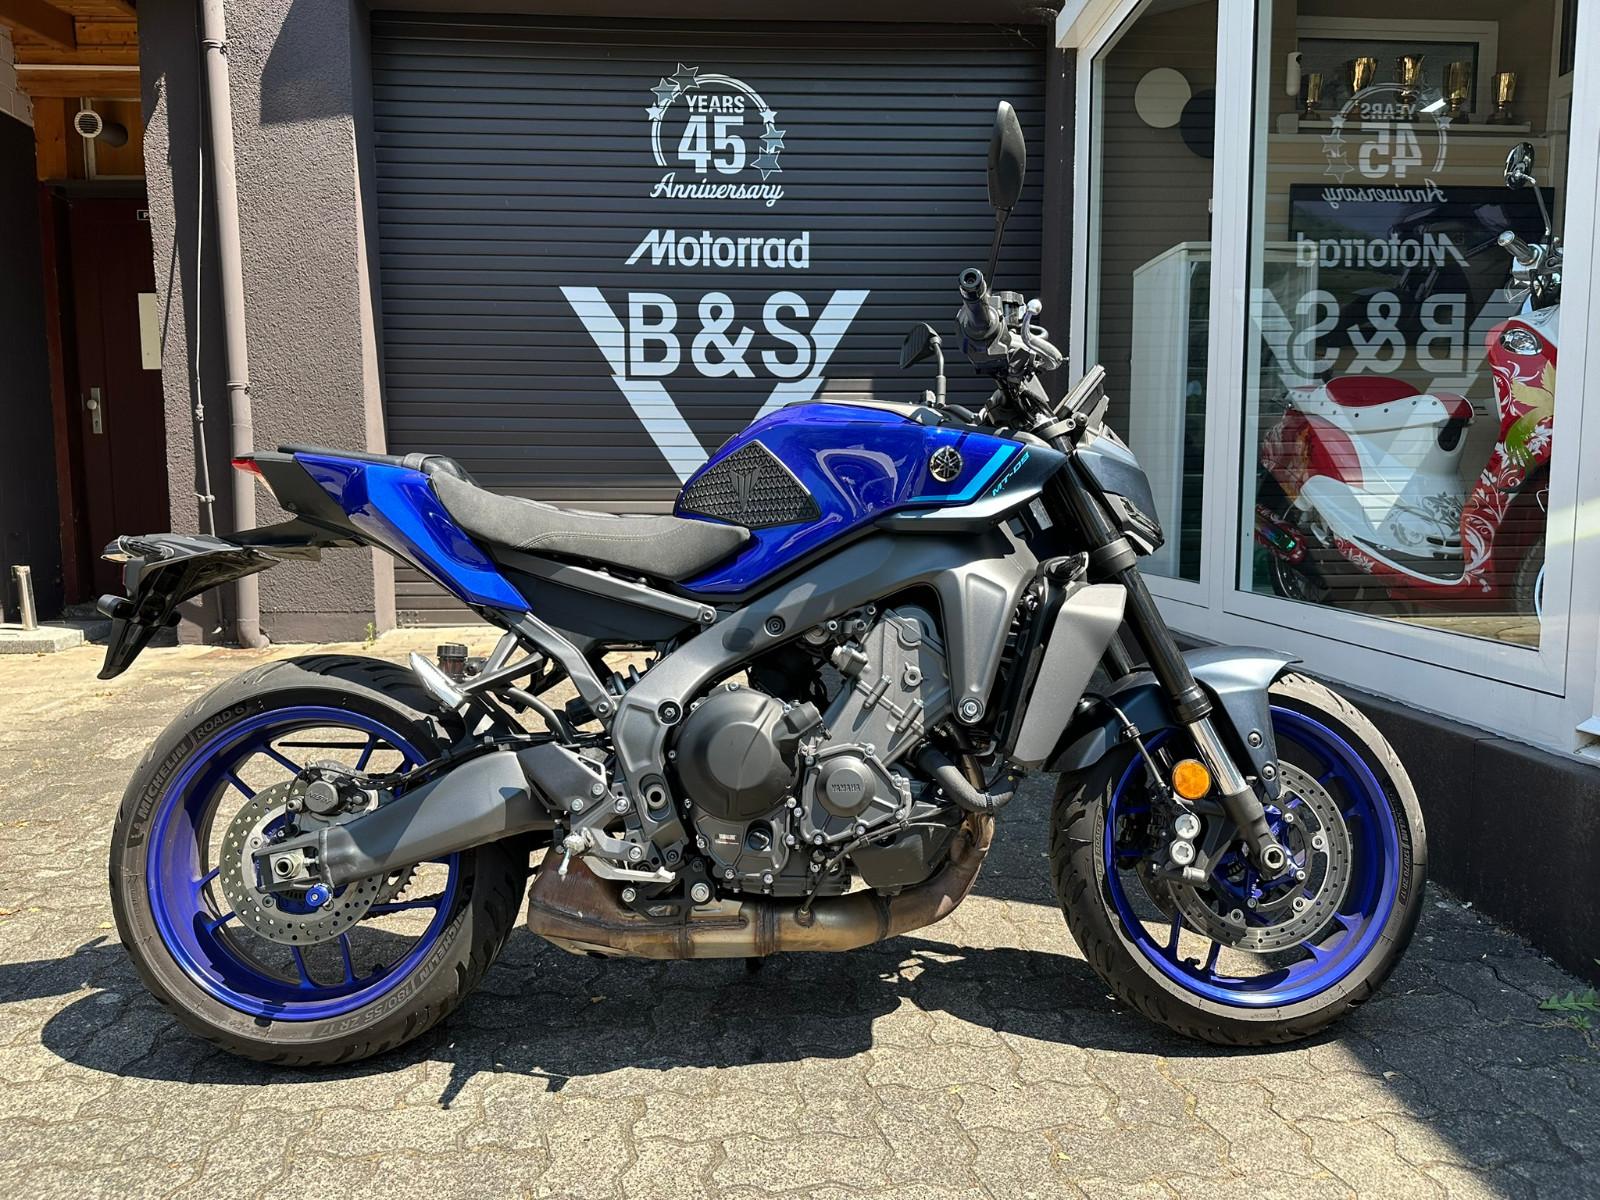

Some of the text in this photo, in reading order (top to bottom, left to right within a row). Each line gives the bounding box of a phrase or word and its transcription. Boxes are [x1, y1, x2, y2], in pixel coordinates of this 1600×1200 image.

[685, 95, 745, 114] YEARS
[677, 115, 746, 174] 45
[649, 172, 784, 207] Anniversary
[624, 229, 810, 268] Motorrad
[138, 743, 189, 821] MICHELIN
[195, 709, 232, 740] ROAD
[831, 783, 861, 792] YAMAHA
[364, 987, 410, 1022] 180/55
